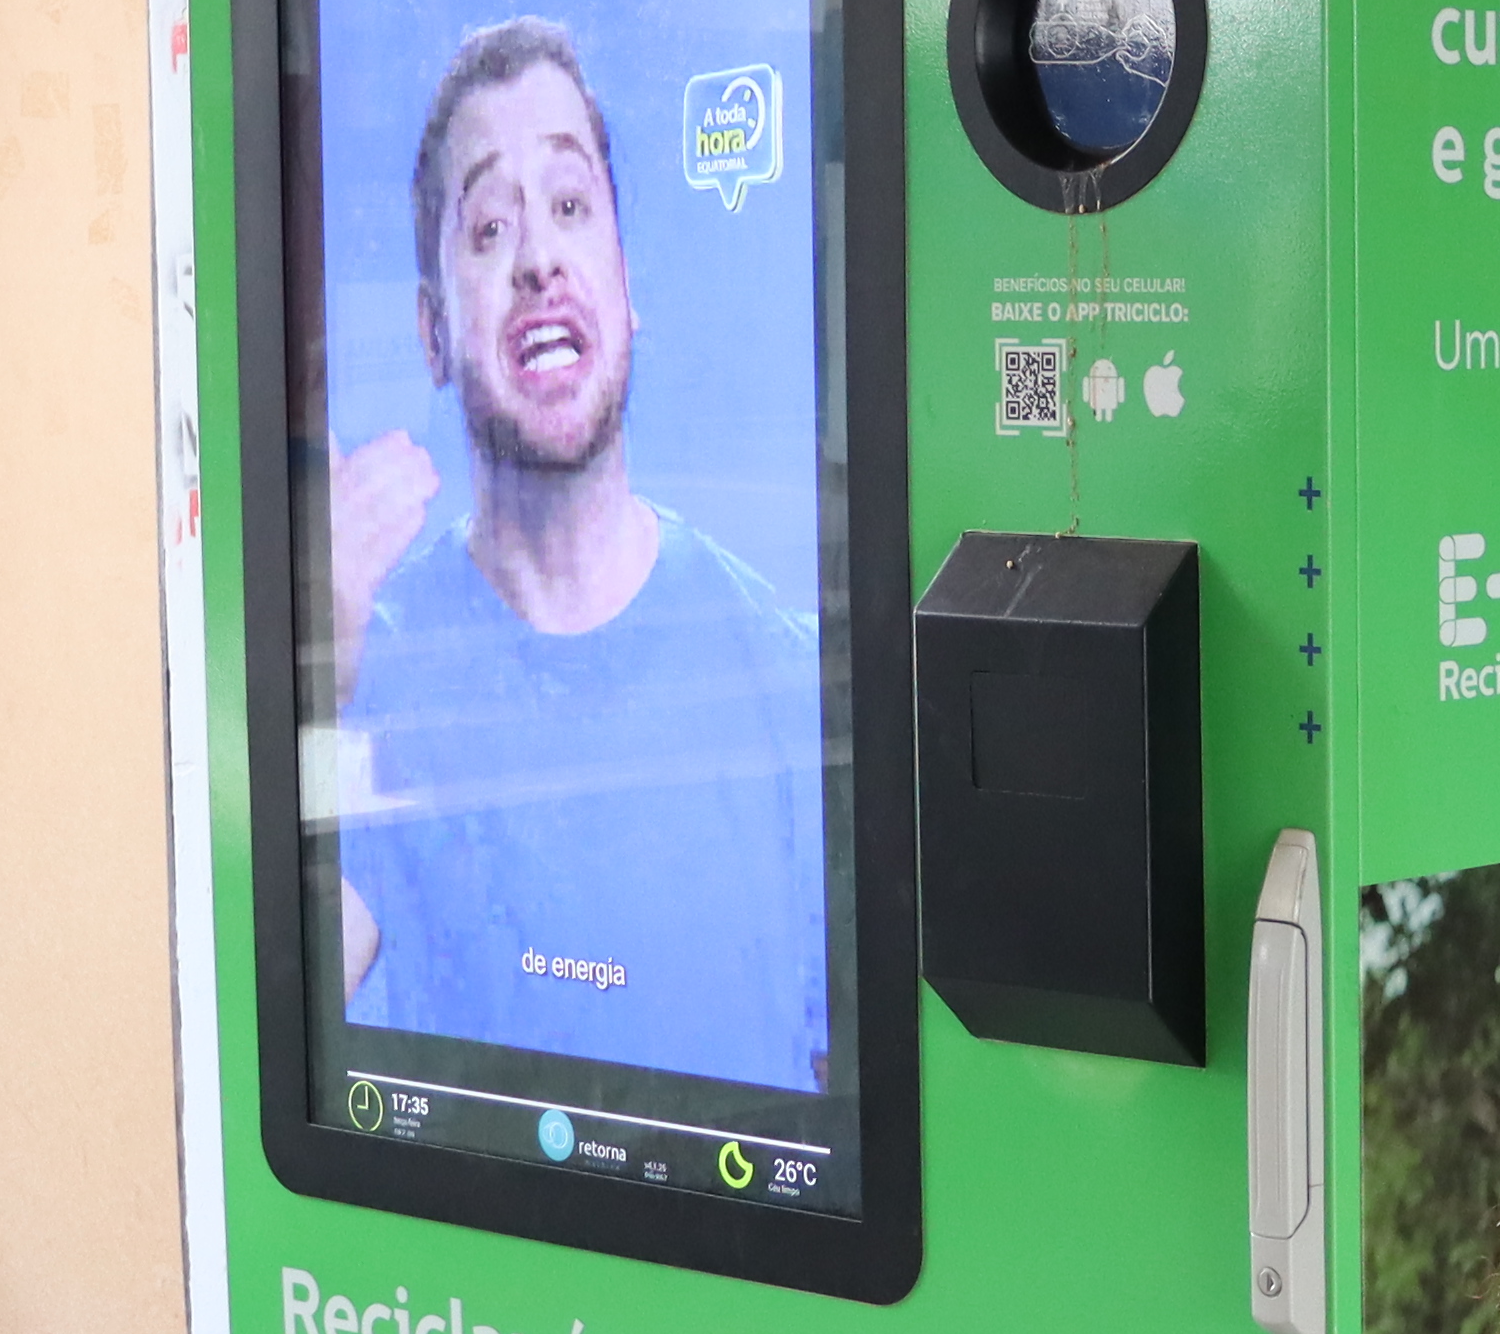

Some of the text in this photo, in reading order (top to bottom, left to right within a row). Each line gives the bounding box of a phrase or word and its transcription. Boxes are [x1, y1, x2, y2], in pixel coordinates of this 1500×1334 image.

[703, 103, 747, 127] A toda
[695, 125, 747, 158] hora
[696, 157, 749, 173] EQUATORIAL
[1432, 124, 1465, 184] e
[993, 272, 1186, 293] BENEFÍCIOS NO SEU CELULAR!
[991, 302, 1190, 323] BAIXE O APP TRICICLO:
[1433, 319, 1500, 370] Um
[521, 947, 626, 990] de energia
[391, 1093, 430, 1116] 17:35
[578, 1139, 627, 1162] retorna
